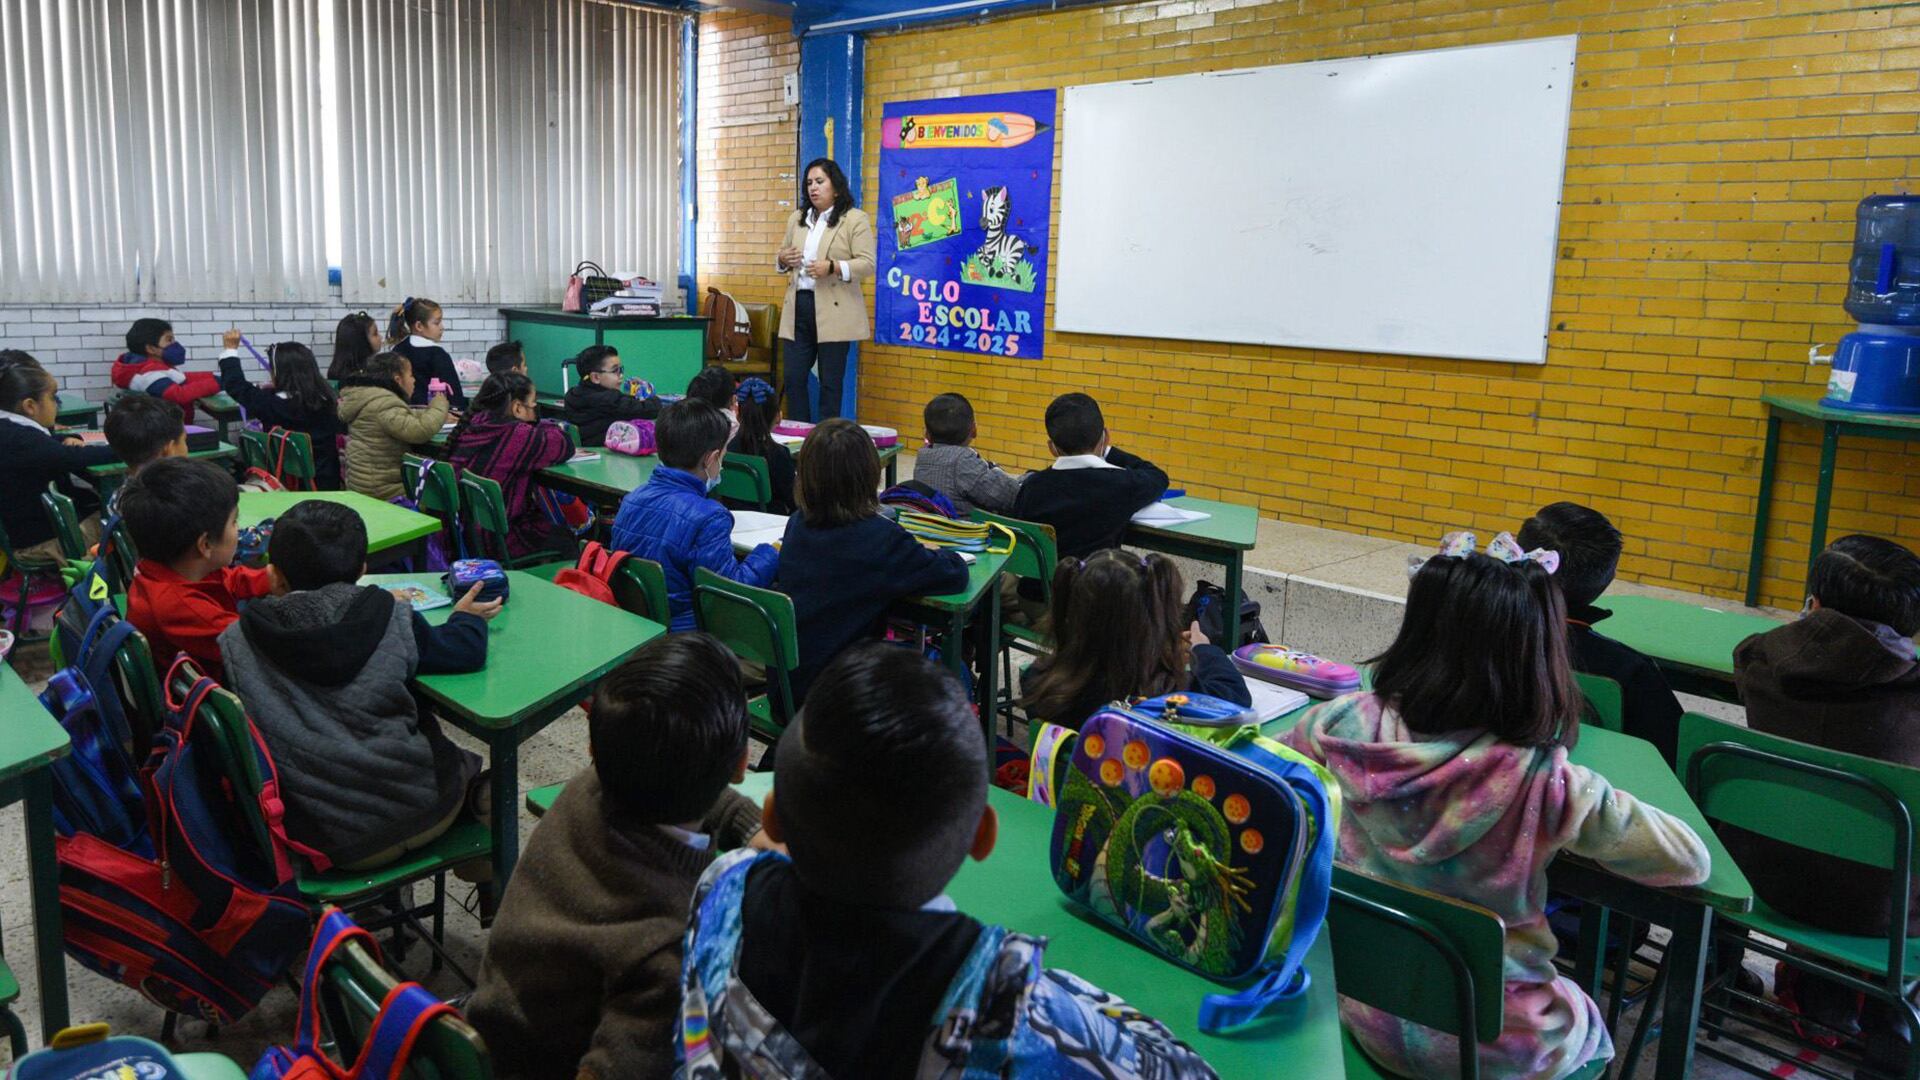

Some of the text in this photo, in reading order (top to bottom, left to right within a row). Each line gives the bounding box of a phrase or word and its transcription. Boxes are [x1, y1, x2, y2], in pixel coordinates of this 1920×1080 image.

[917, 124, 984, 139] BIENVENIDOS
[927, 197, 946, 225] C
[888, 267, 960, 303] CICLO
[918, 302, 1032, 334] ESCOLAR
